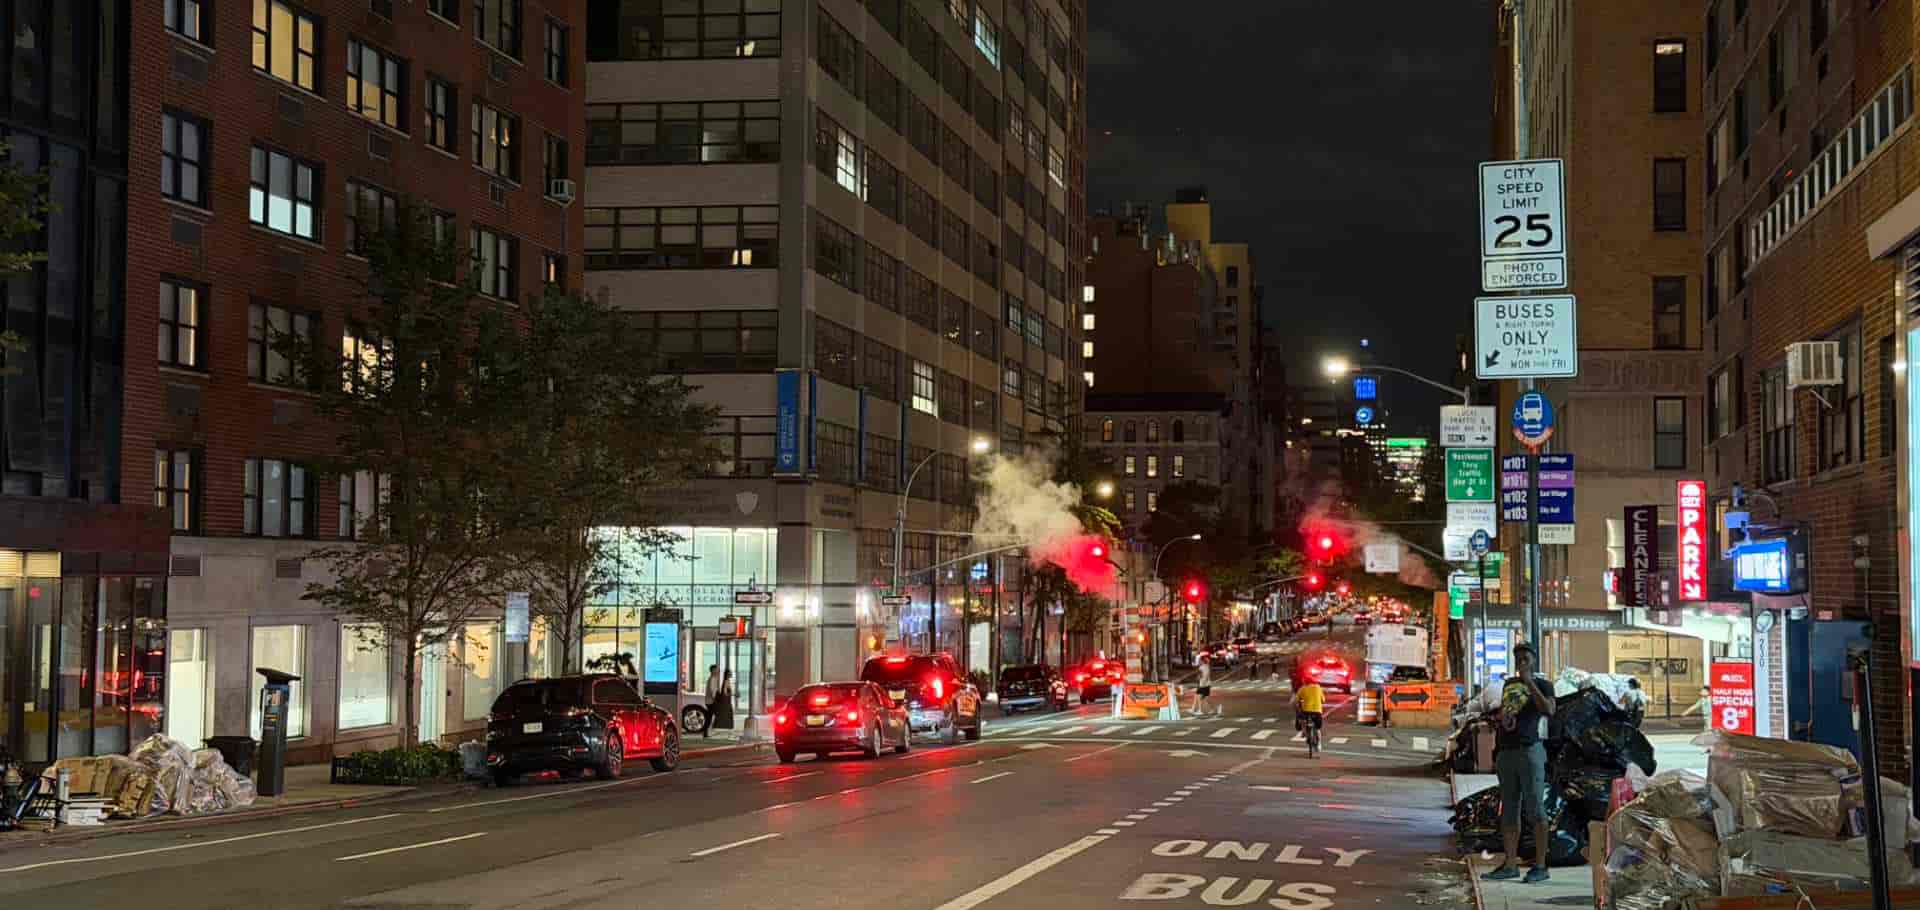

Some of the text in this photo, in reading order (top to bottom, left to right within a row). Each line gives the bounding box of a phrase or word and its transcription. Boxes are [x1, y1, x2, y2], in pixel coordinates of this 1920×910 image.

[1503, 168, 1536, 180] CITY
[1497, 182, 1544, 195] SPEED
[1502, 197, 1540, 209] LIMIT
[1494, 214, 1553, 249] 25
[1504, 263, 1544, 273] PHOTO
[1492, 273, 1557, 285] ENFORCED
[1496, 304, 1555, 319] BUSES
[1502, 330, 1548, 346] ONLY
[1552, 360, 1568, 368] FRI
[1682, 510, 1701, 581] PARK
[1567, 617, 1612, 628] Diner
[1151, 839, 1377, 867] ONLY
[1118, 873, 1337, 910] BUS
